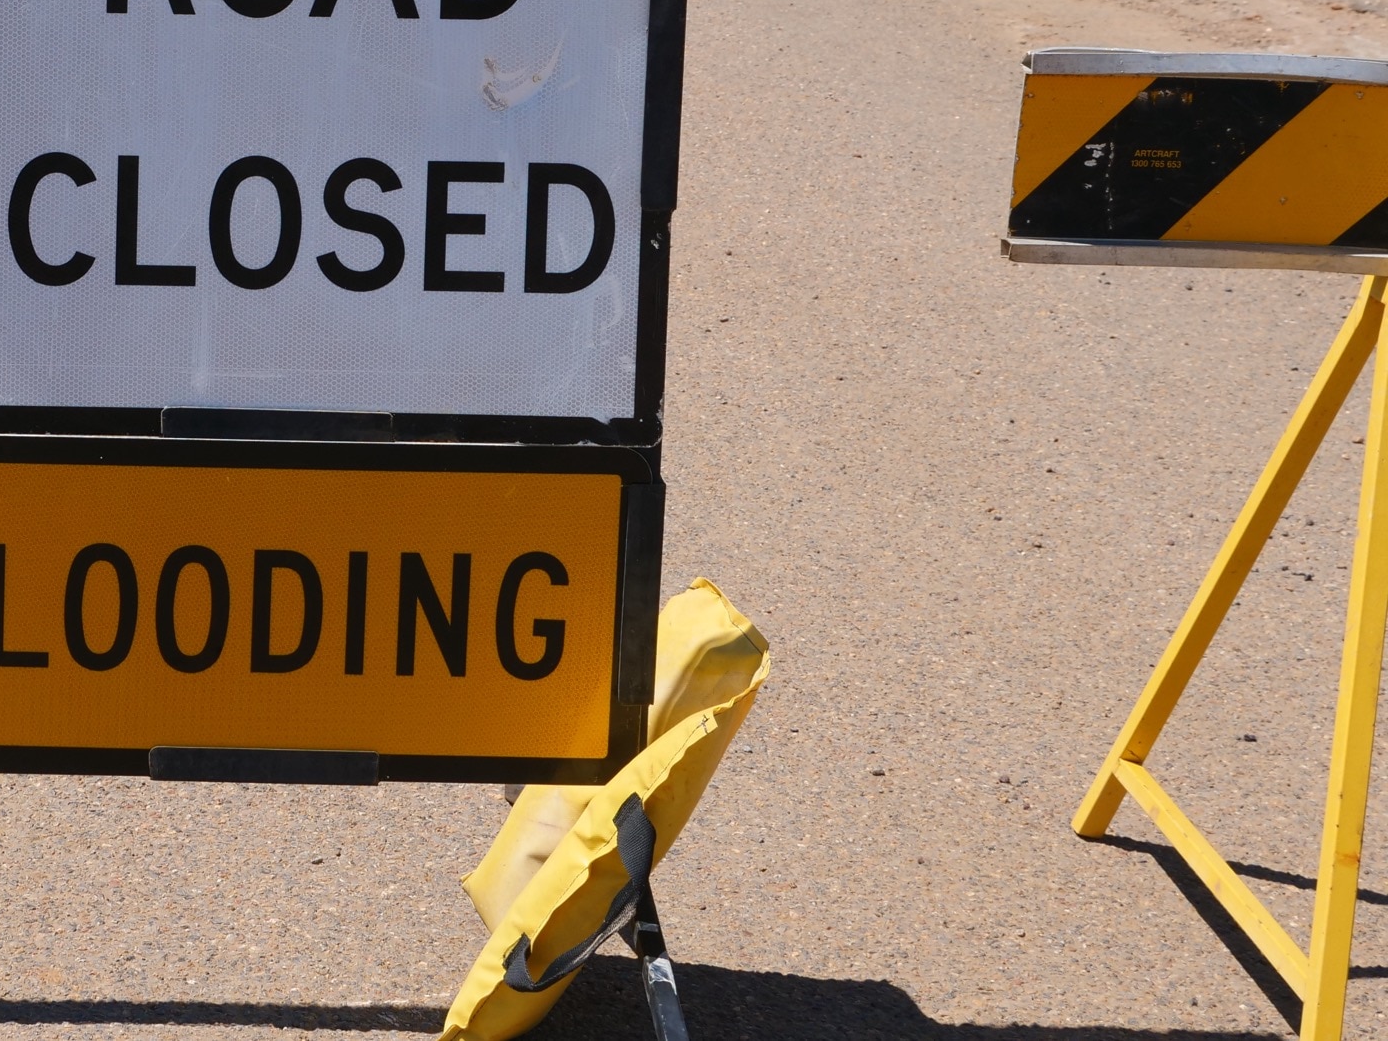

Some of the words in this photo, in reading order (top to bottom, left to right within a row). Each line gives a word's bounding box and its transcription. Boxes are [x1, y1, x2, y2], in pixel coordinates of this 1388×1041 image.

[1134, 149, 1180, 158] ARTCRAFT
[1131, 160, 1149, 168] 1300
[7, 151, 616, 294] CLOSED
